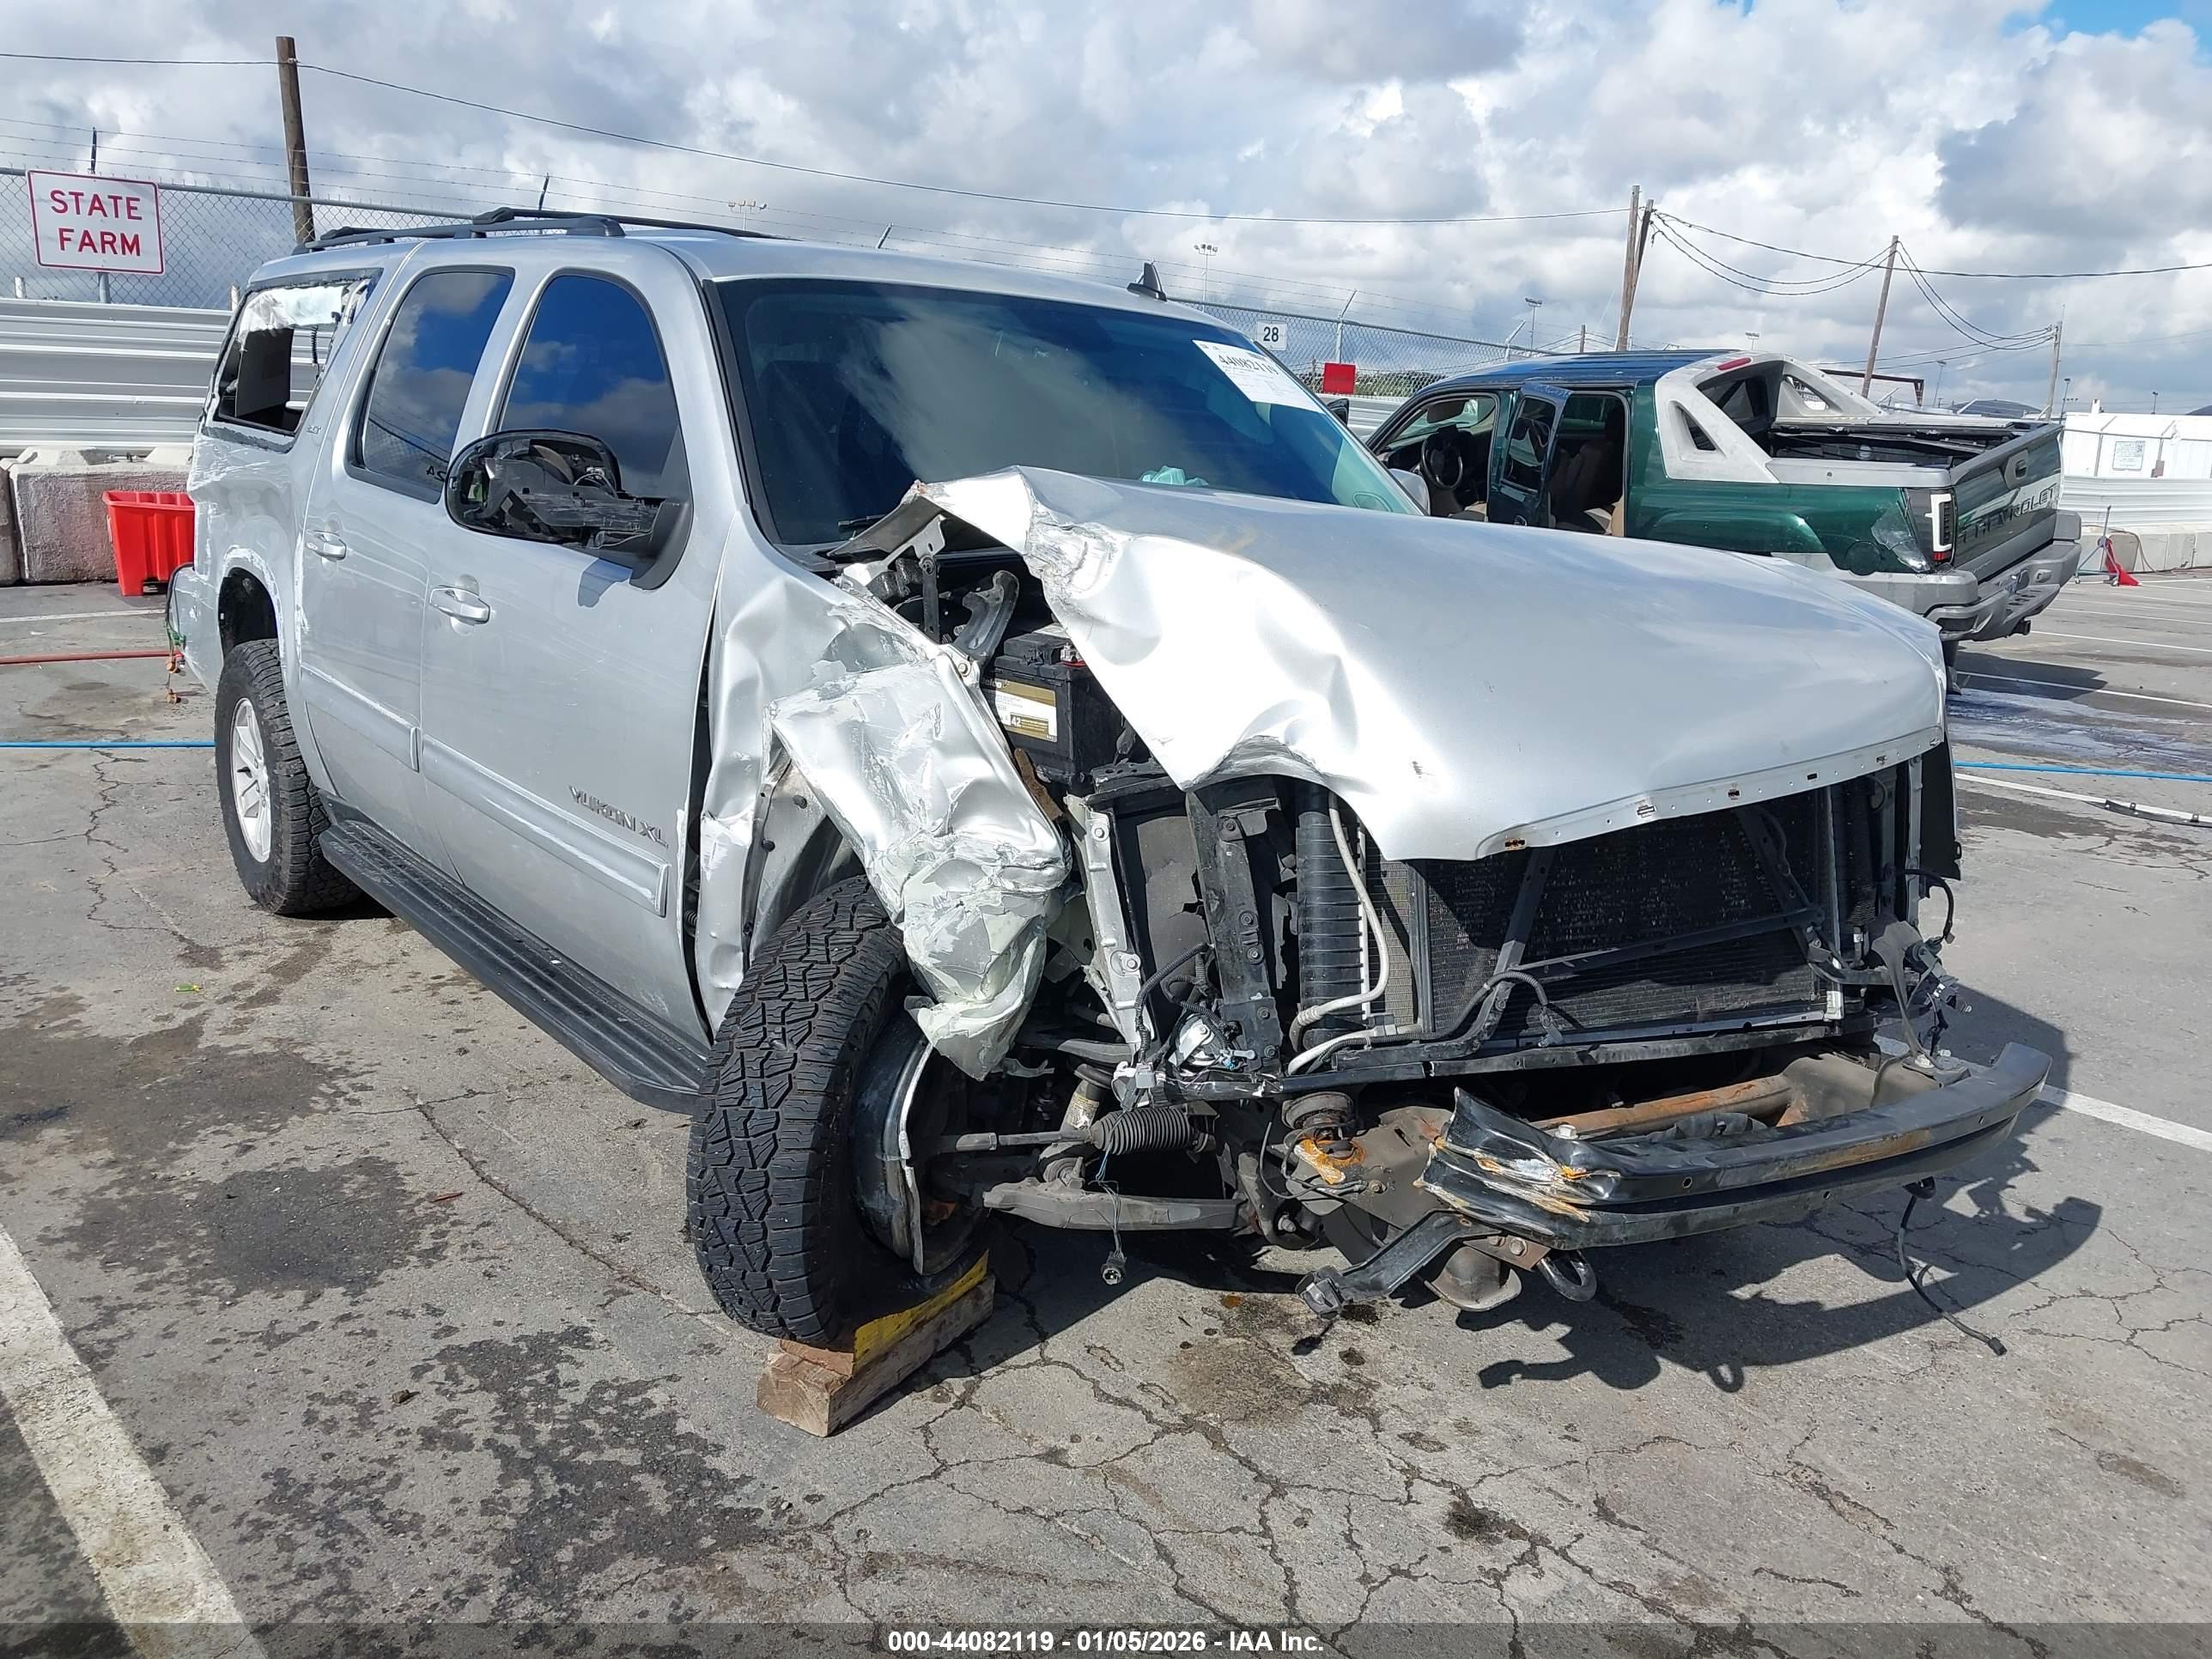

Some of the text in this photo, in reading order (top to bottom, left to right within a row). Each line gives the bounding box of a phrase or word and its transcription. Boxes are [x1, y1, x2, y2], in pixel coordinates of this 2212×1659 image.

[50, 189, 143, 221] STATE
[58, 228, 141, 256] FARM
[1263, 326, 1279, 342] 28
[569, 786, 668, 849] YUKON XL
